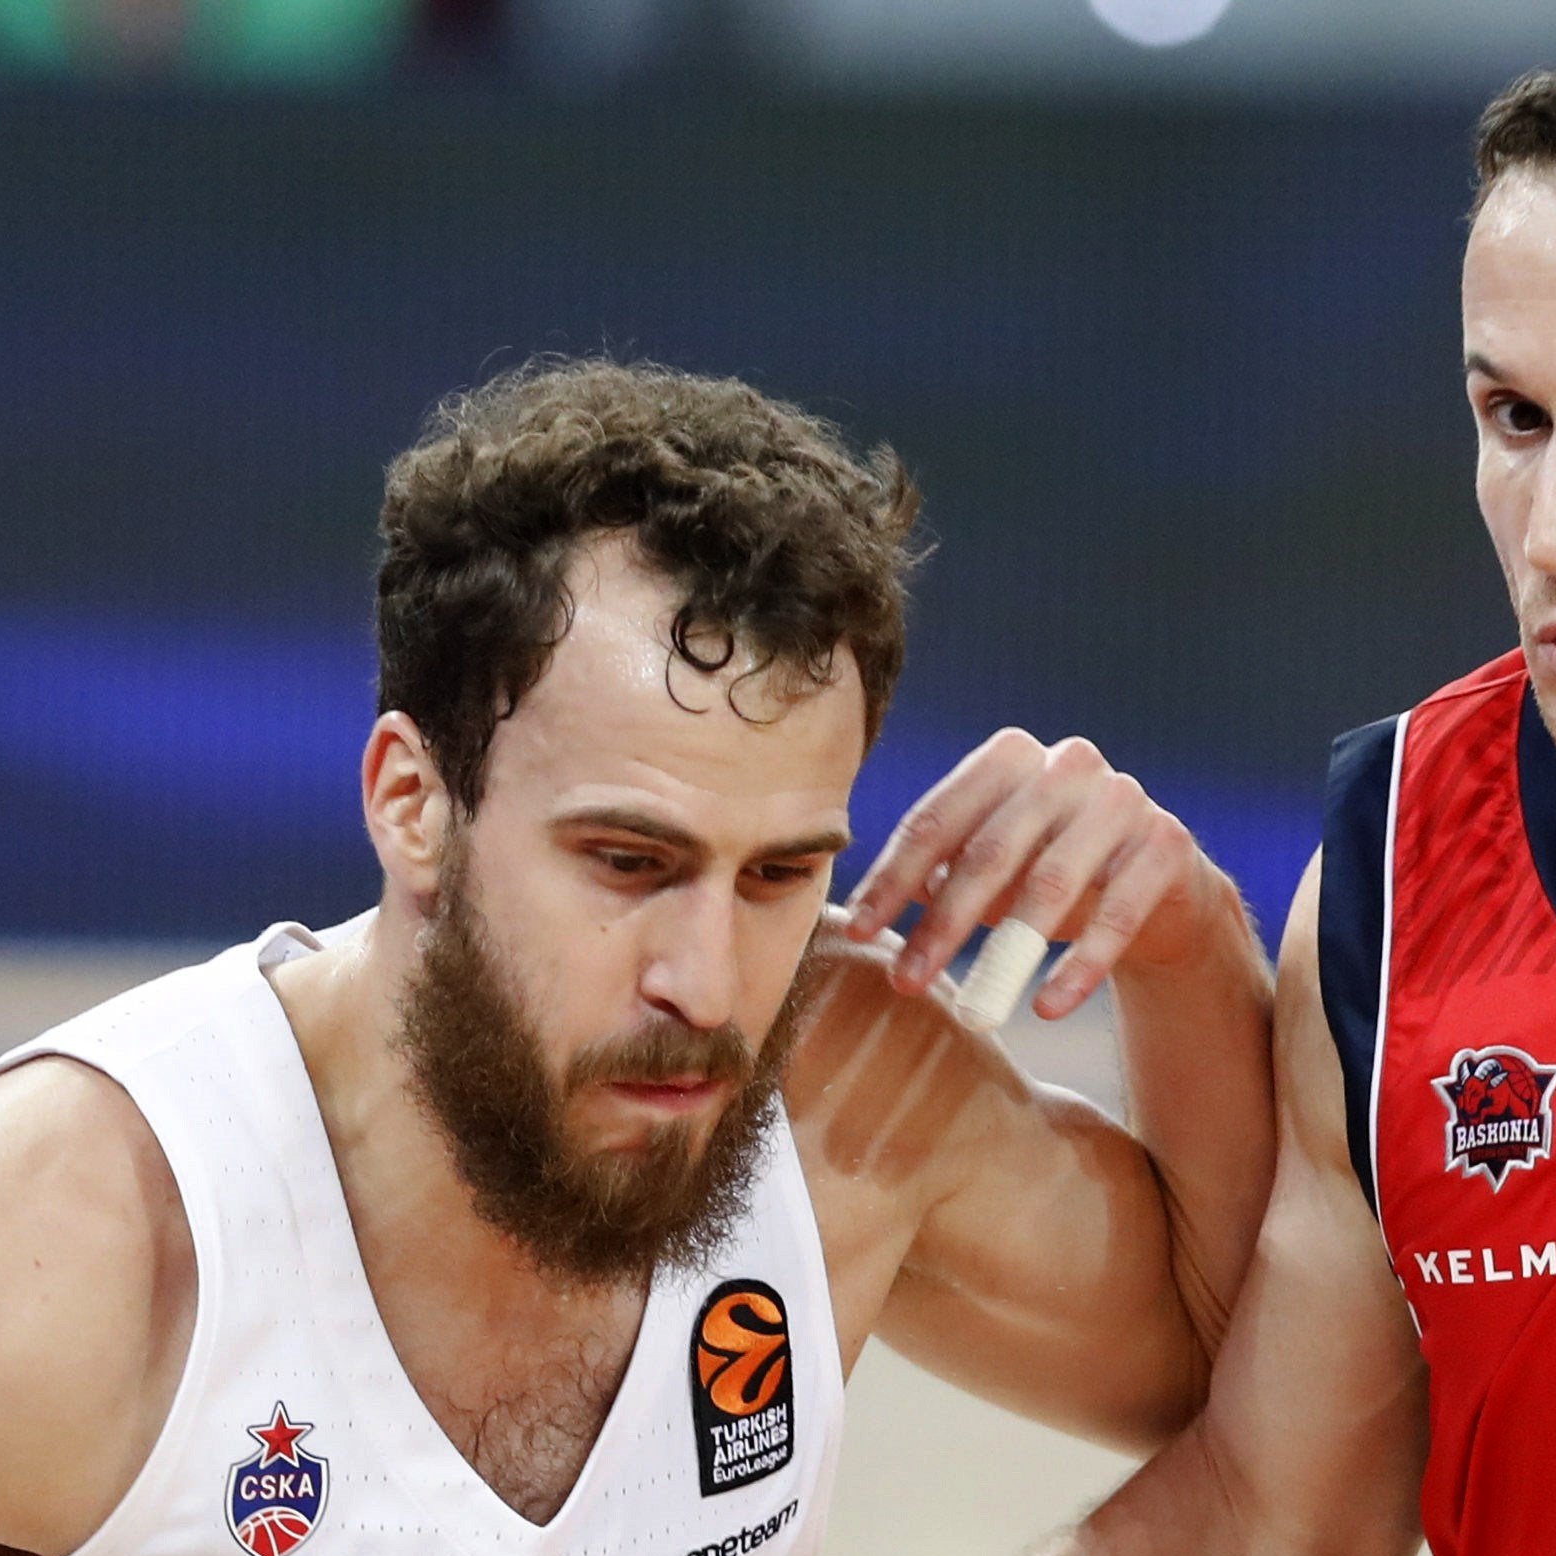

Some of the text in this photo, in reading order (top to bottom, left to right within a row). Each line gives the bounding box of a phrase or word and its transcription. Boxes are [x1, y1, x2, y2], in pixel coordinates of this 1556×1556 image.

[1456, 1118, 1541, 1153] BASKONIA
[710, 1403, 788, 1447] TURKISH
[713, 1423, 789, 1468] AIRLINES
[240, 1473, 315, 1501] CSKA
